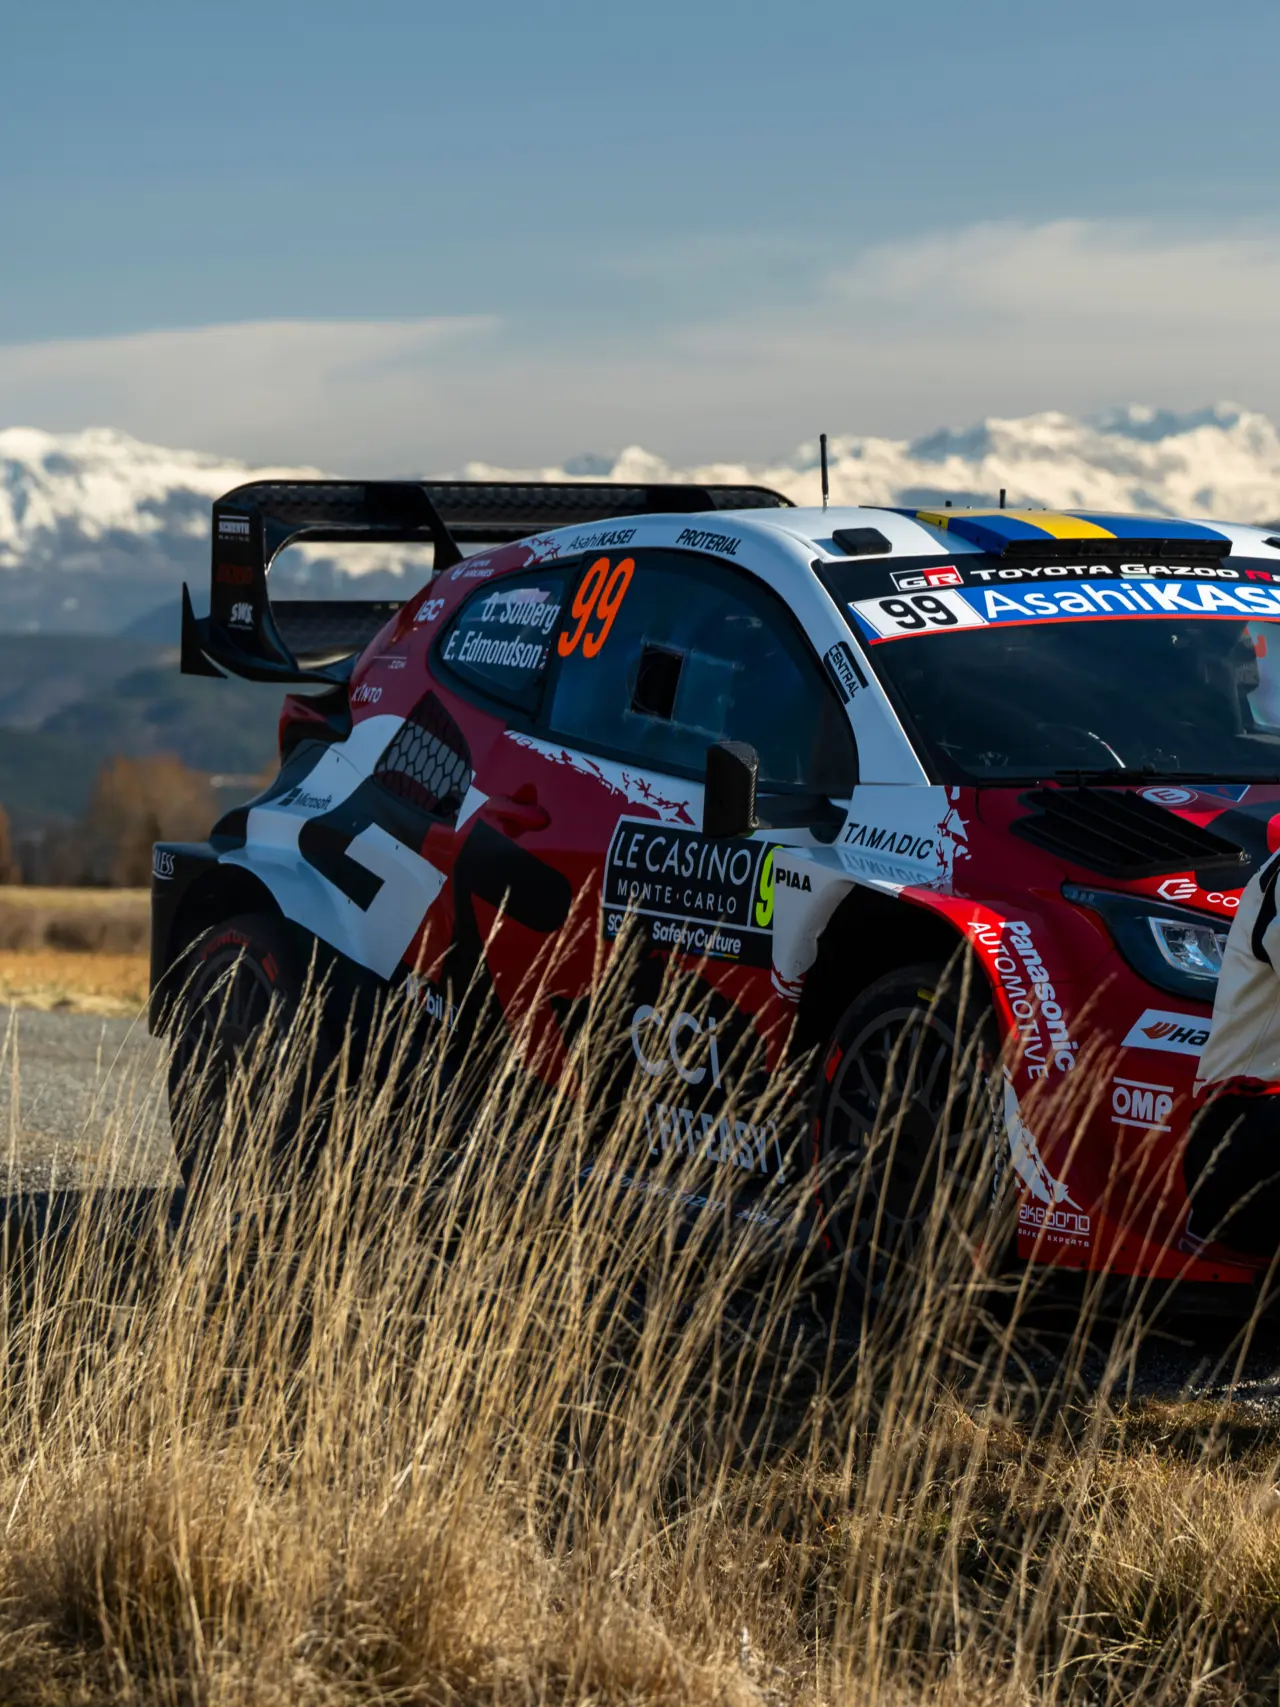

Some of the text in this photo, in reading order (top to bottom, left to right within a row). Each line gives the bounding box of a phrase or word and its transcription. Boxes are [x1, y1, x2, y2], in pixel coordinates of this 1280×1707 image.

[567, 529, 640, 551] AsahiKASEI
[676, 528, 742, 555] PROTERIAL
[898, 573, 961, 589] GR
[970, 565, 1113, 581] TOYOTA
[1119, 563, 1239, 579] GAZOO
[500, 593, 561, 635] Solberg
[558, 557, 636, 658] 99
[879, 594, 958, 630] 99
[443, 630, 543, 669] E. Edmondson
[829, 645, 861, 698] CENTRAL
[351, 682, 383, 703] KINTO
[299, 793, 333, 811] Microsoft
[613, 830, 753, 885] LE CASINO
[843, 822, 934, 859] TAMADIC
[775, 868, 812, 892] PIAA
[652, 920, 741, 954] SafetyCulture
[967, 921, 1049, 1079] AUTOMOTIVE
[998, 920, 1079, 1072] Panasonic
[1112, 1086, 1173, 1123] OMP
[1019, 1203, 1091, 1232] akebono
[1018, 1228, 1090, 1247] BRAK EXPERTS
